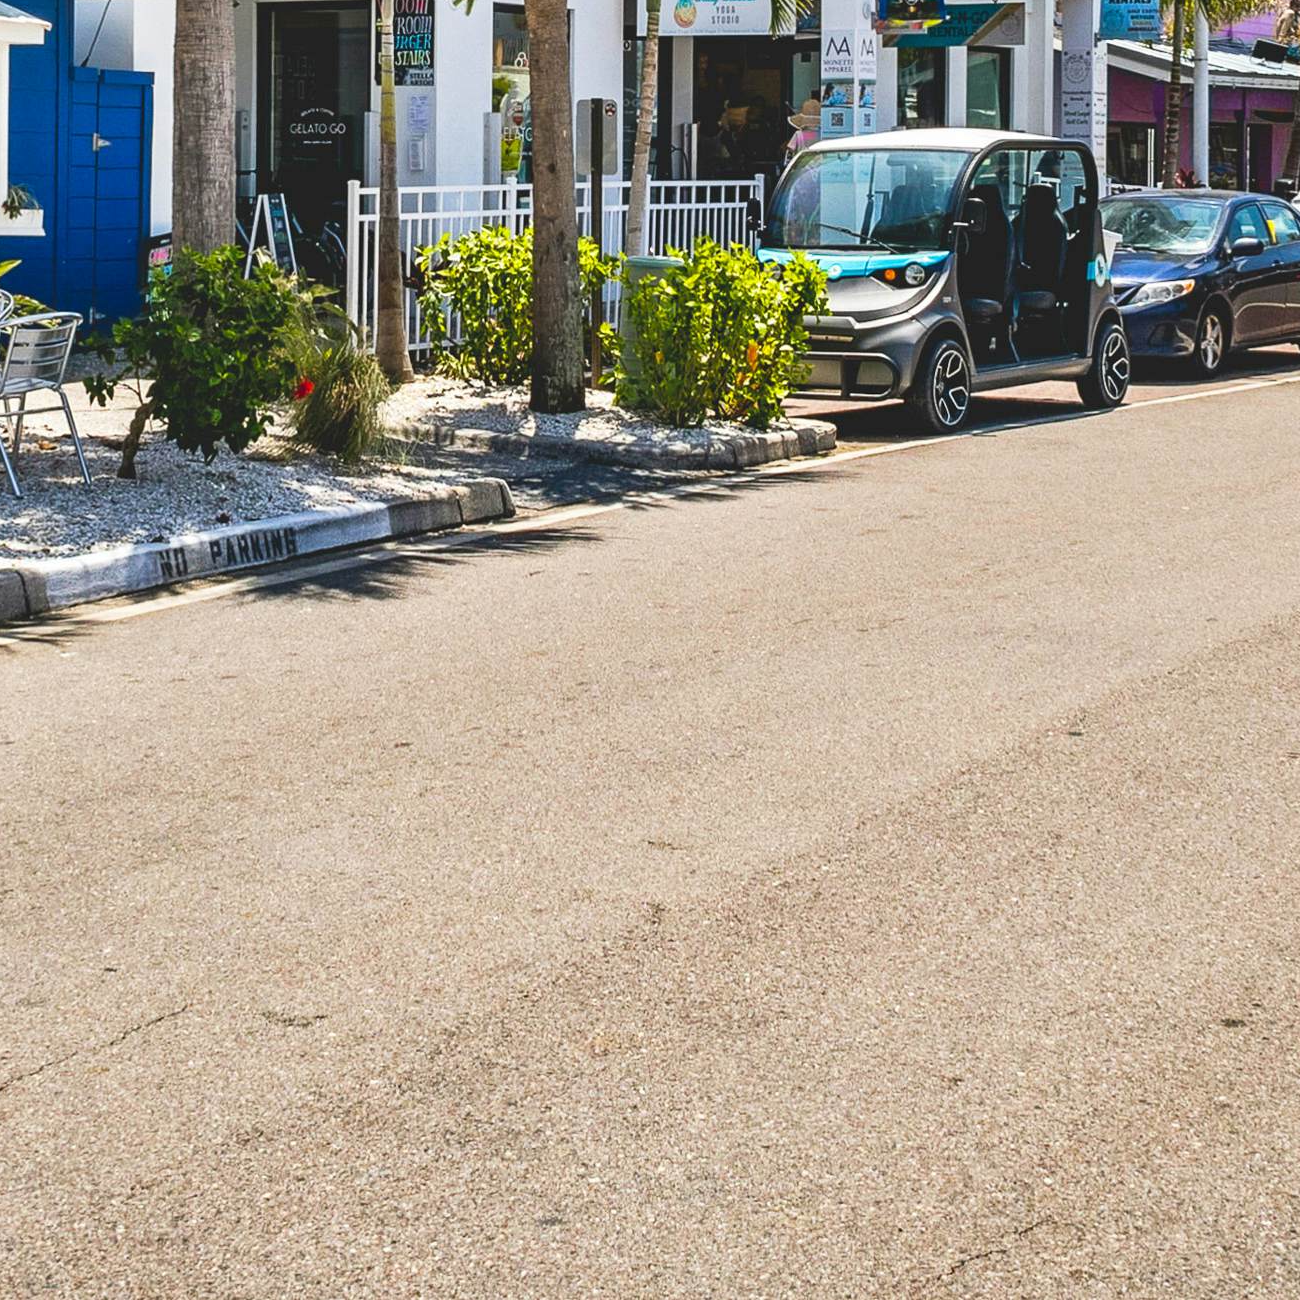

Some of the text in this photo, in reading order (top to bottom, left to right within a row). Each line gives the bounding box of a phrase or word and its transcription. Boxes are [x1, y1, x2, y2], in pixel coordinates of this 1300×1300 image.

[716, 6, 735, 14] YOGA
[712, 16, 739, 24] STUDIO
[290, 123, 347, 134] GELATO GO
[159, 527, 298, 578] NO PARKING
